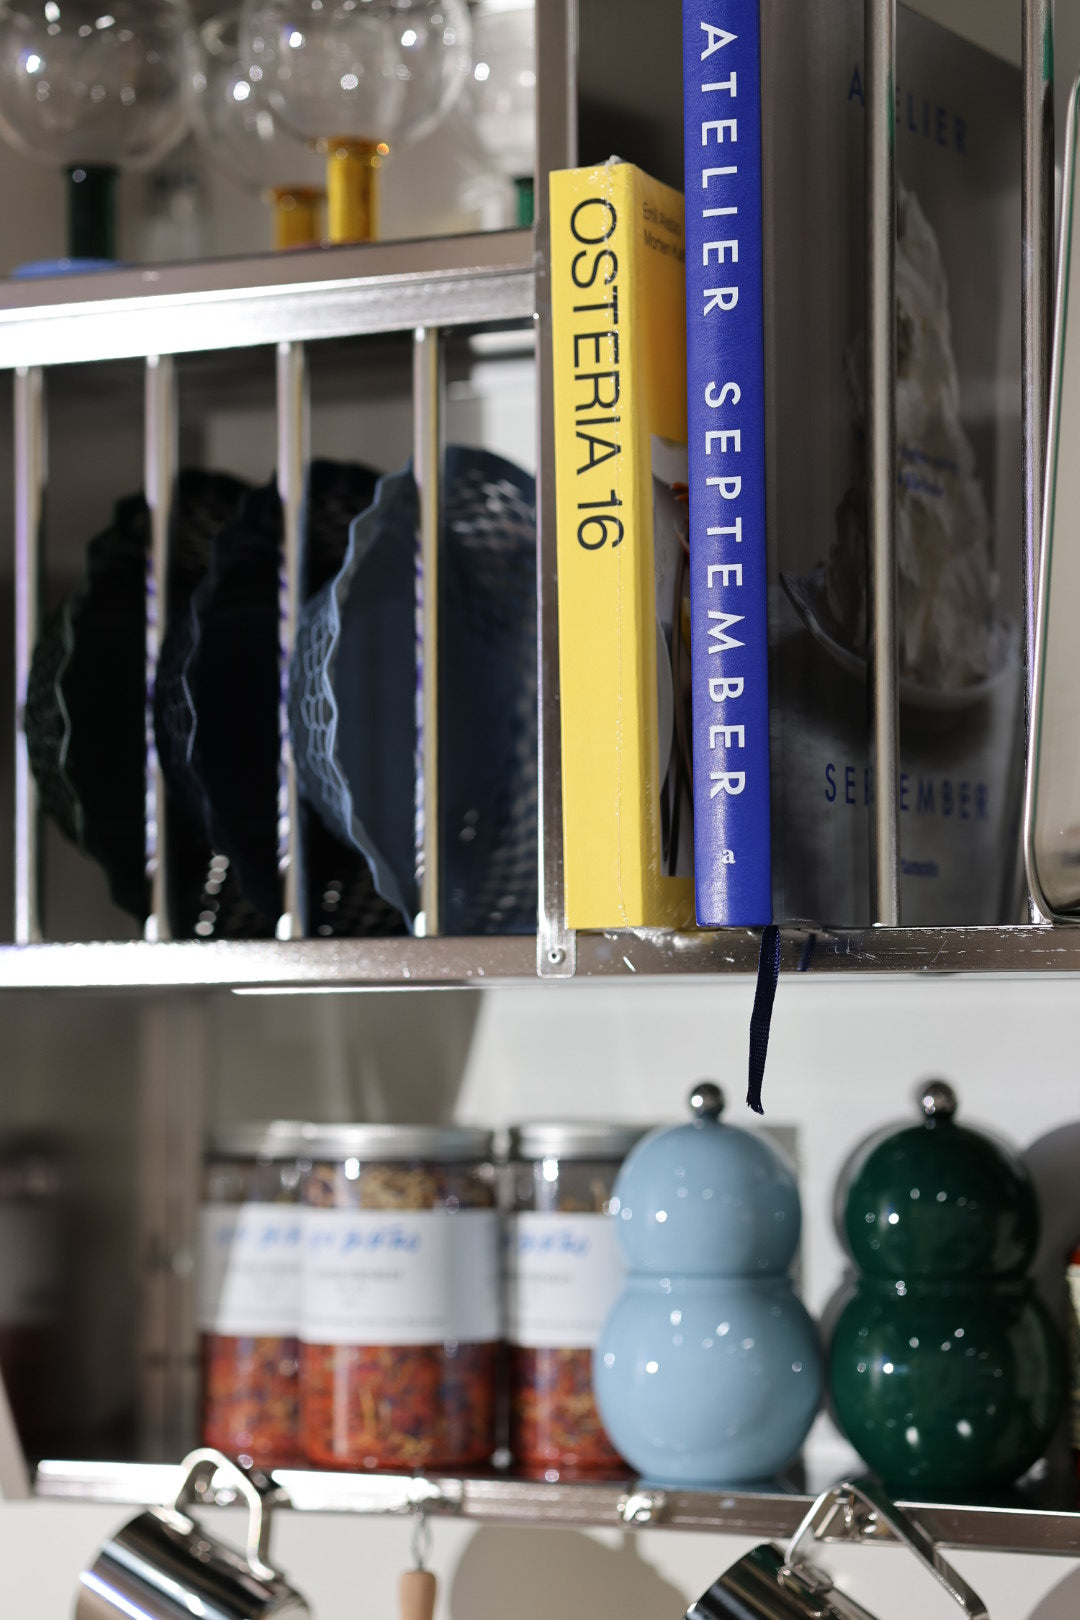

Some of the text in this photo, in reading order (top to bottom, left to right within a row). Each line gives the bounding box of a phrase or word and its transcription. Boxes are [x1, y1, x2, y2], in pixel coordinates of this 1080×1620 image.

[569, 197, 625, 551] OSTERIA 16
[700, 21, 746, 800] ATELIER SEPTEMBER
[721, 849, 736, 865] a
